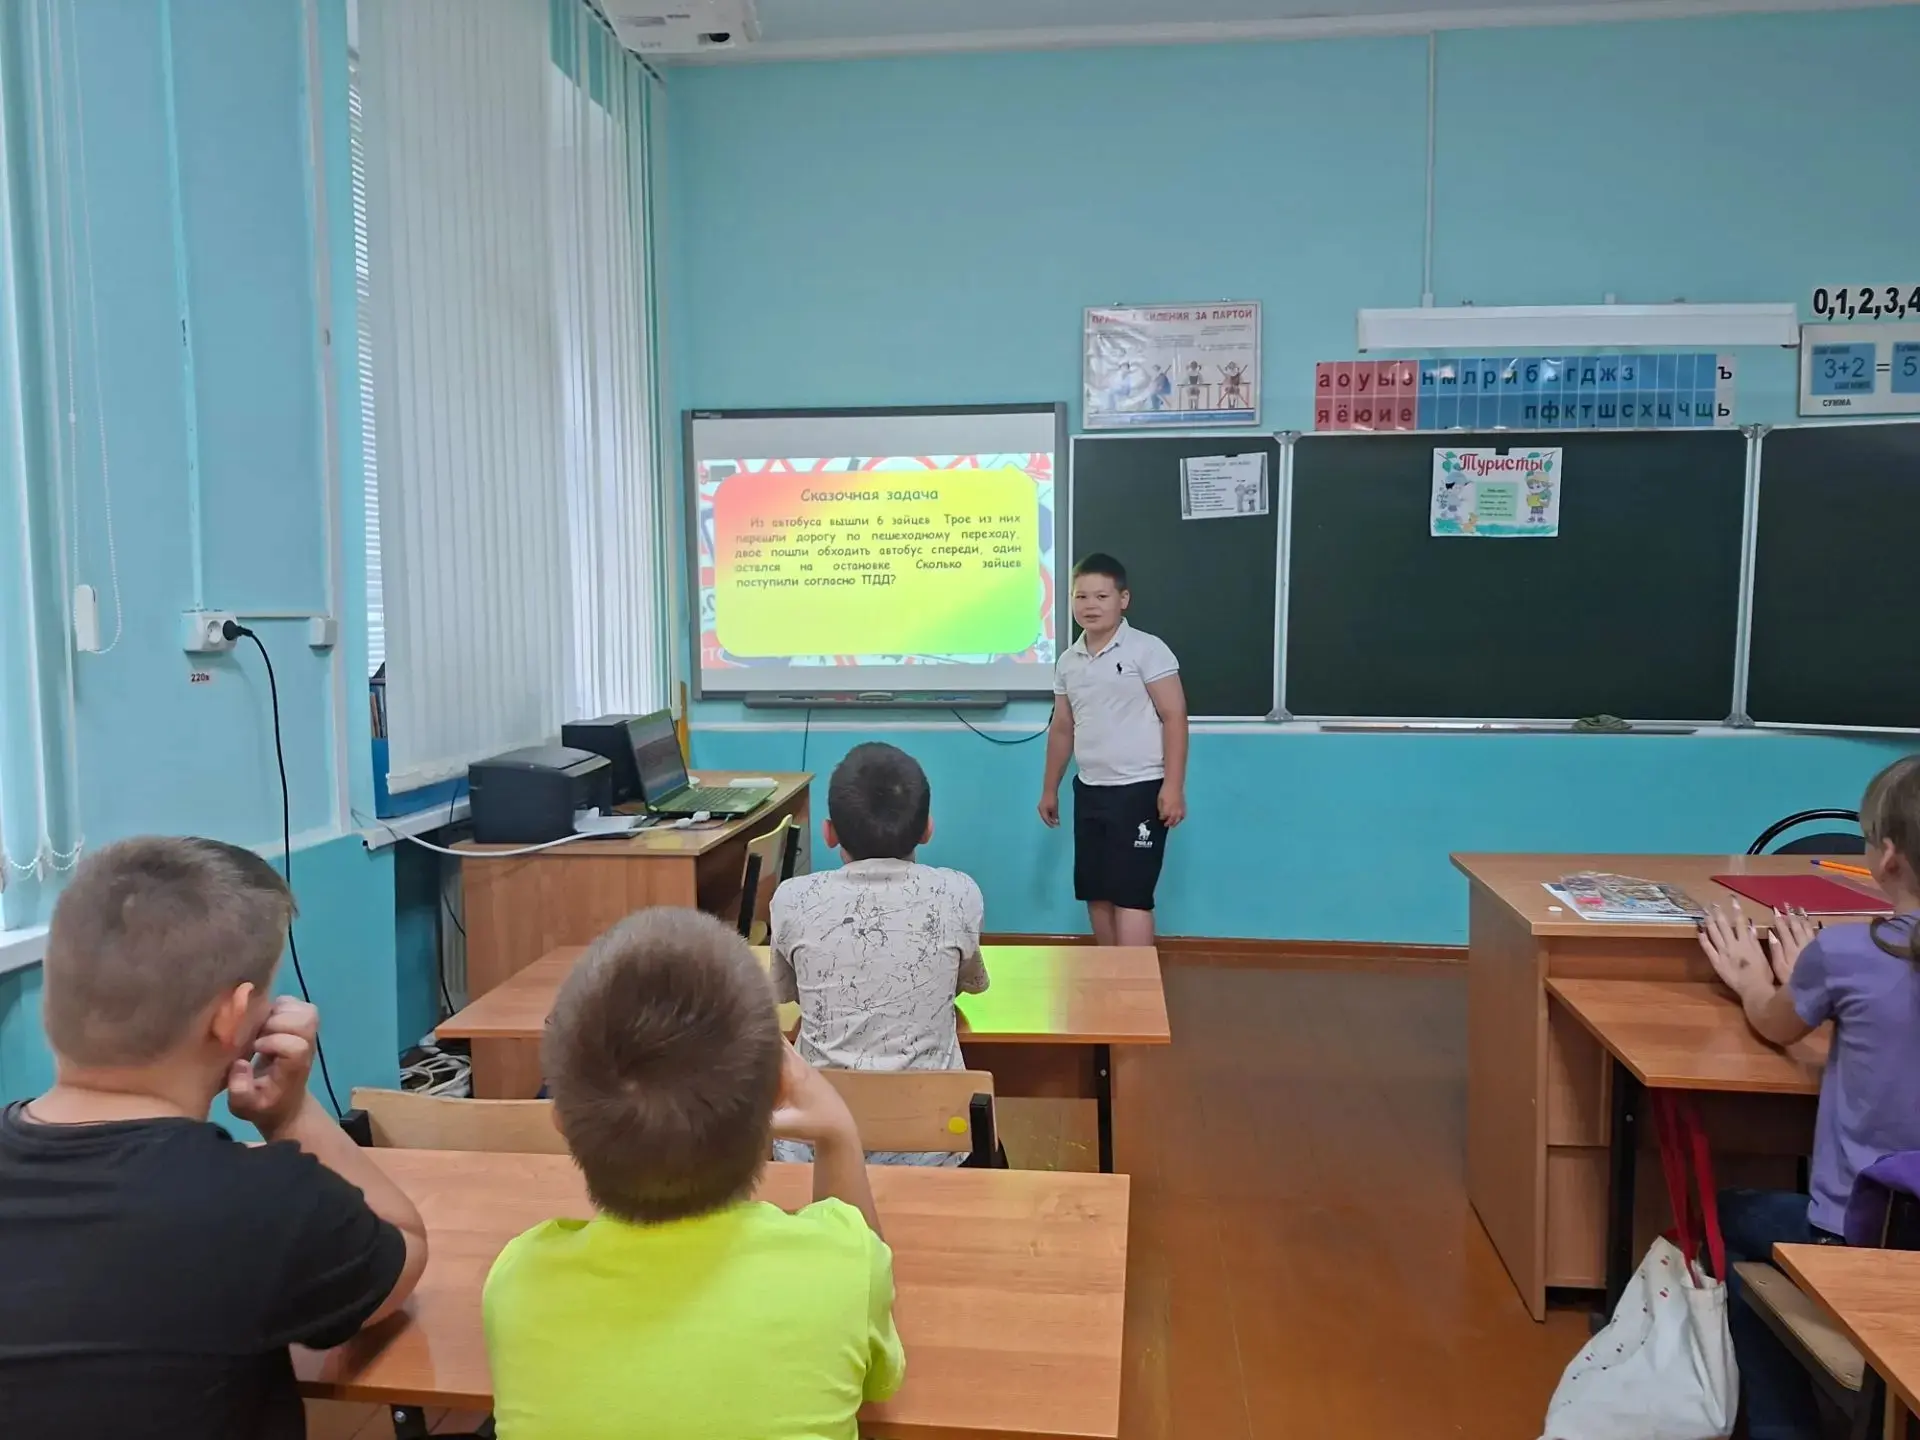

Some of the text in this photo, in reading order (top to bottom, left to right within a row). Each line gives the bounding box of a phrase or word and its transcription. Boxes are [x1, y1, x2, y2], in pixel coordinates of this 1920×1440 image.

[1195, 311, 1207, 321] ЗА
[1903, 356, 1917, 377] 5
[1459, 453, 1543, 476] Туристы
[800, 488, 939, 502] Сказочная задача
[772, 516, 821, 529] автобуса
[830, 517, 869, 526] вышли
[877, 516, 884, 526] 6
[979, 515, 992, 523] из
[999, 514, 1021, 523] них
[736, 534, 786, 544] перешли
[796, 532, 836, 544] дорогу
[846, 532, 861, 541] по
[871, 531, 950, 542] пешеходному
[735, 549, 762, 559] двое
[771, 548, 809, 557] пошли
[817, 545, 870, 557] обходить
[879, 544, 923, 557] автобус
[992, 543, 1022, 554] один
[735, 562, 781, 573] остался
[800, 562, 813, 571] на
[915, 559, 962, 570] Сколько
[982, 557, 1022, 569] зайцев
[736, 574, 897, 590] поступили согласно ПДД?
